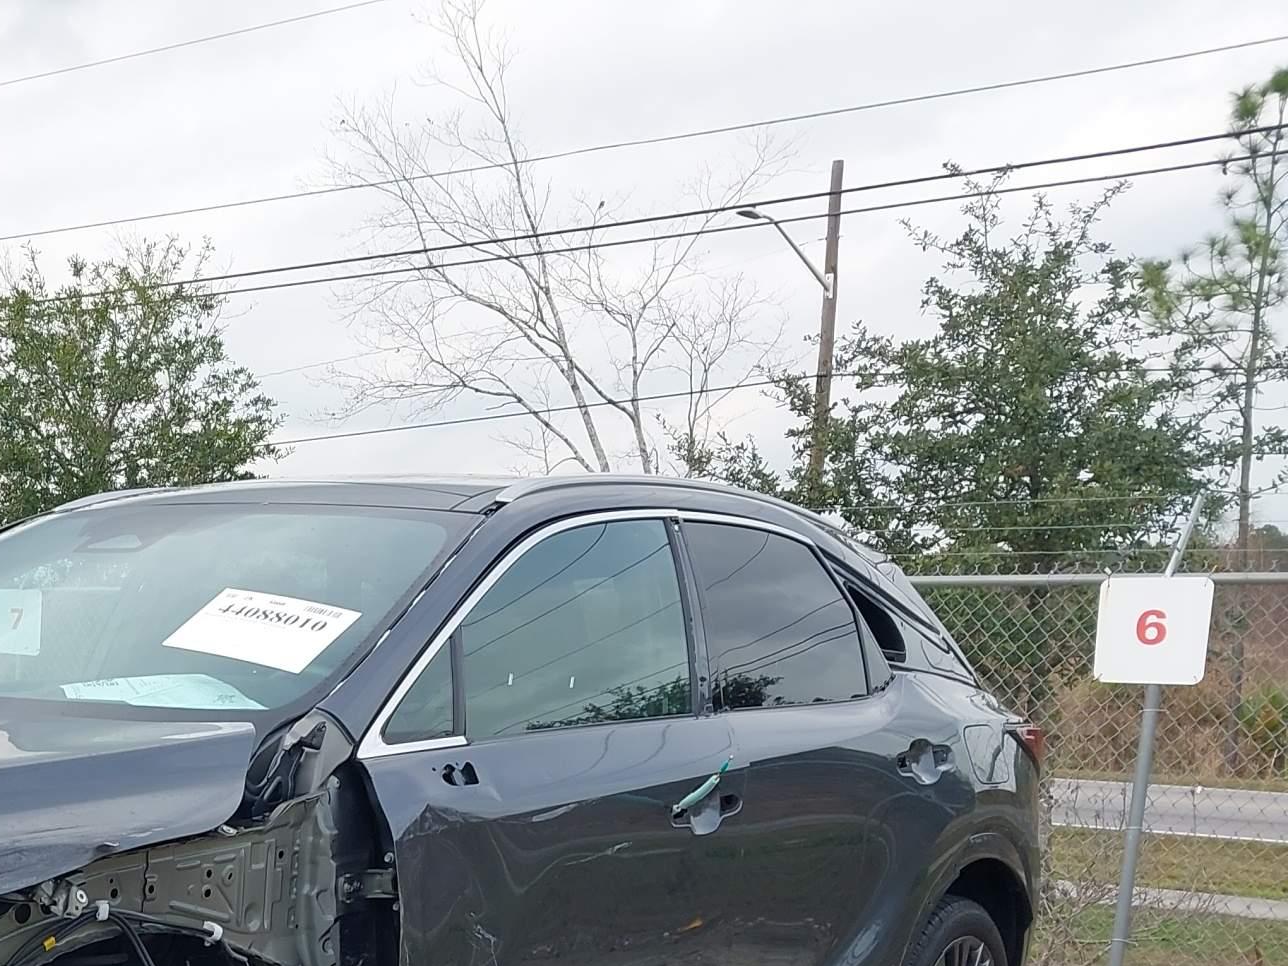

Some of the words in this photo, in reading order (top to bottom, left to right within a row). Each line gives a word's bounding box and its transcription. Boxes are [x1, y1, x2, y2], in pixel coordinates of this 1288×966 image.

[10, 607, 24, 630] 7
[218, 603, 328, 632] 44088010
[1136, 609, 1167, 646] 6
